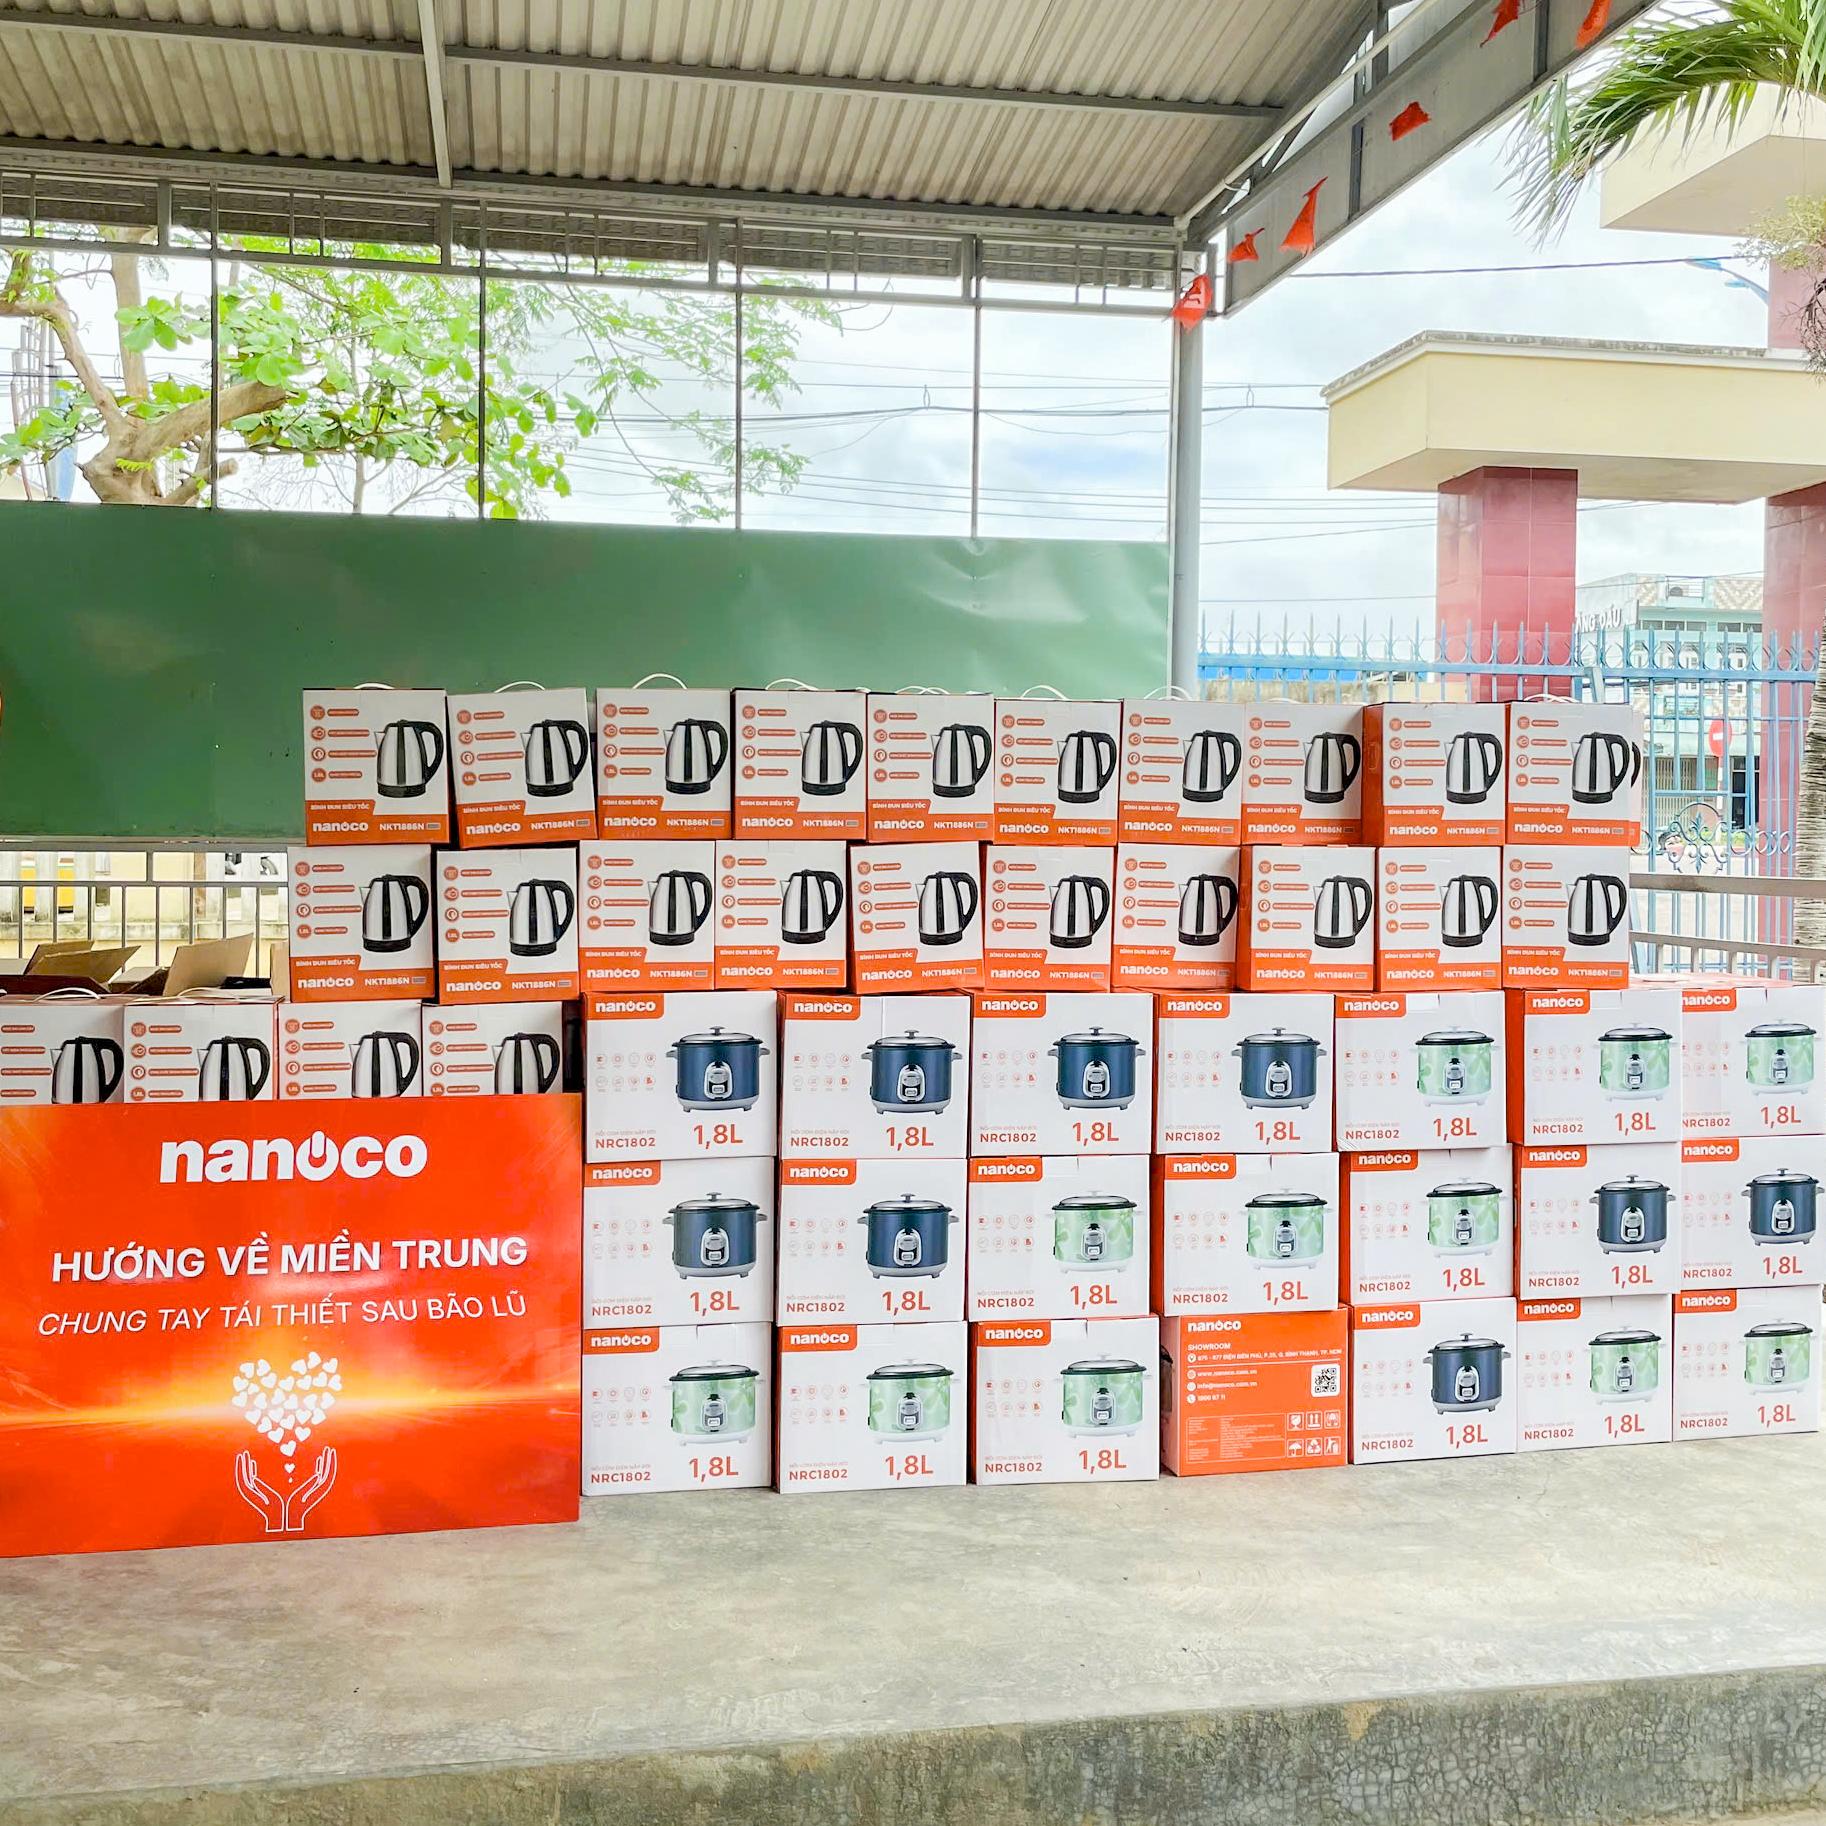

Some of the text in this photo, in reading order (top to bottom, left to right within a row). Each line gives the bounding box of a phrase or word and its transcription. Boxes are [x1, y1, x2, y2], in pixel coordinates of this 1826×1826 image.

[313, 821, 368, 831] nanoco
[466, 822, 521, 834] nanoco
[604, 817, 657, 827] nanoco
[742, 817, 793, 827] nanoco
[875, 819, 924, 829] nanoco
[1000, 823, 1048, 833] nanoco
[1125, 821, 1172, 832] nanoco
[1248, 823, 1296, 833] nanoco
[1515, 823, 1563, 833] nanoco
[1390, 825, 1437, 835] nanoco
[587, 968, 640, 978] nanoco
[721, 966, 772, 976] nanoco
[862, 969, 912, 981] nanoco
[991, 969, 1040, 978] nanoco
[1121, 965, 1168, 975] nanoco
[1257, 968, 1305, 979] nanoco
[1387, 969, 1434, 979] nanoco
[1508, 966, 1558, 976] nanoco
[298, 977, 354, 988] nanoco
[446, 981, 501, 991] nanoco
[596, 1000, 656, 1013] nanoco
[794, 1001, 852, 1013] nanoco
[982, 999, 1038, 1011] nanoco
[1168, 1000, 1222, 1012] nanoco
[1344, 1000, 1399, 1011] nanoco
[1532, 997, 1583, 1008] nanoco
[1682, 1106, 1802, 1129] NRC1802 1,8L
[1345, 1117, 1477, 1141] NRC1802 1,8L
[1533, 1112, 1656, 1136] NRC1802 1,8L
[595, 1124, 744, 1149] NRC1802 1,8L
[791, 1126, 934, 1151] NRC1802 1,8L
[980, 1122, 1120, 1146] NRC1802 1,8L
[1165, 1121, 1301, 1145] NRC1802 1,8L
[1529, 1150, 1580, 1162] nanoco
[1684, 1145, 1733, 1156] nanoco
[160, 1131, 428, 1183] nanoco
[1358, 1153, 1411, 1165] nanoco
[592, 1167, 652, 1179] nanoco
[790, 1166, 848, 1178] nanoco
[978, 1163, 1035, 1176] nanoco
[1173, 1161, 1229, 1173] nanoco
[52, 1229, 528, 1282] HƯỚNG VỀ MIỀN TRUNG
[1683, 1255, 1803, 1279] NRC1802 1,8L
[1359, 1267, 1486, 1292] NRC1802 1,8L
[1528, 1264, 1654, 1288] NRC1802 1,8L
[978, 1285, 1118, 1309] NRC1802 1,8L
[1173, 1281, 1308, 1306] NRC1802 1,8L
[592, 1291, 740, 1317] NRC1802 1,8L
[786, 1291, 931, 1316] NRC1802 1,8L
[1682, 1295, 1731, 1307] nanoco
[38, 1289, 527, 1337] CHUNG TAY TÁI THIẾT SAU BÃO LŨ
[1523, 1302, 1574, 1315] nanoco
[1361, 1310, 1413, 1323] nanoco
[1188, 1319, 1242, 1332] nanoco
[791, 1332, 849, 1345] nanoco
[985, 1327, 1043, 1340] nanoco
[591, 1334, 652, 1347] nanoco
[1187, 1343, 1232, 1351] SHOWROOM
[1680, 1405, 1796, 1428] NRC1802 1,8L
[1524, 1414, 1645, 1441] NRC1802 1,8L
[1361, 1424, 1488, 1450] NRC1802 1,8L
[985, 1449, 1127, 1474] NRC1802 1,8L
[591, 1456, 739, 1484] NRC1802 1,8L
[789, 1455, 934, 1481] NRC1802 1,8L
